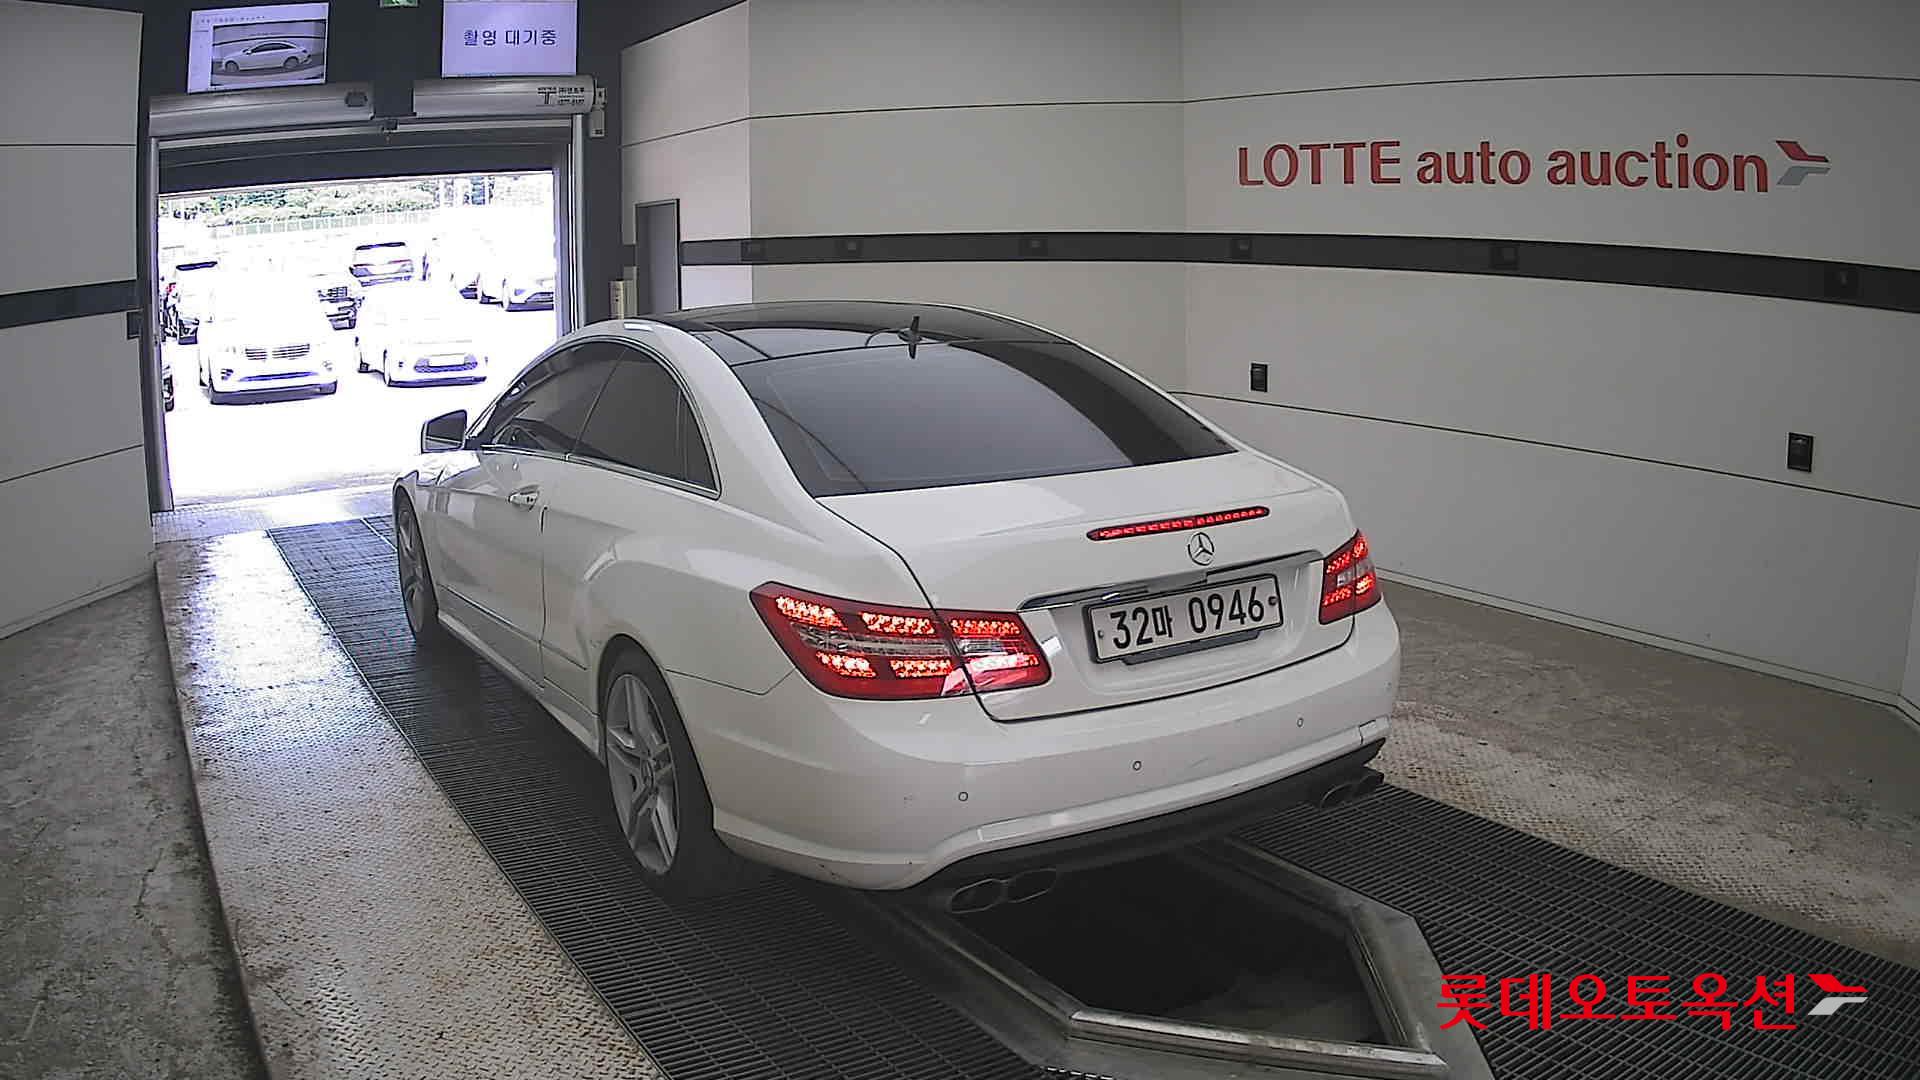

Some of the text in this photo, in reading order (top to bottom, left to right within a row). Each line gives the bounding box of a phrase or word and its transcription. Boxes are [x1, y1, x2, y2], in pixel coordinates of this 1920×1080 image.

[464, 29, 557, 47] 촬영 대기중
[1238, 134, 1769, 192] LOTTE auto auction
[1110, 586, 1265, 649] 32마 0946
